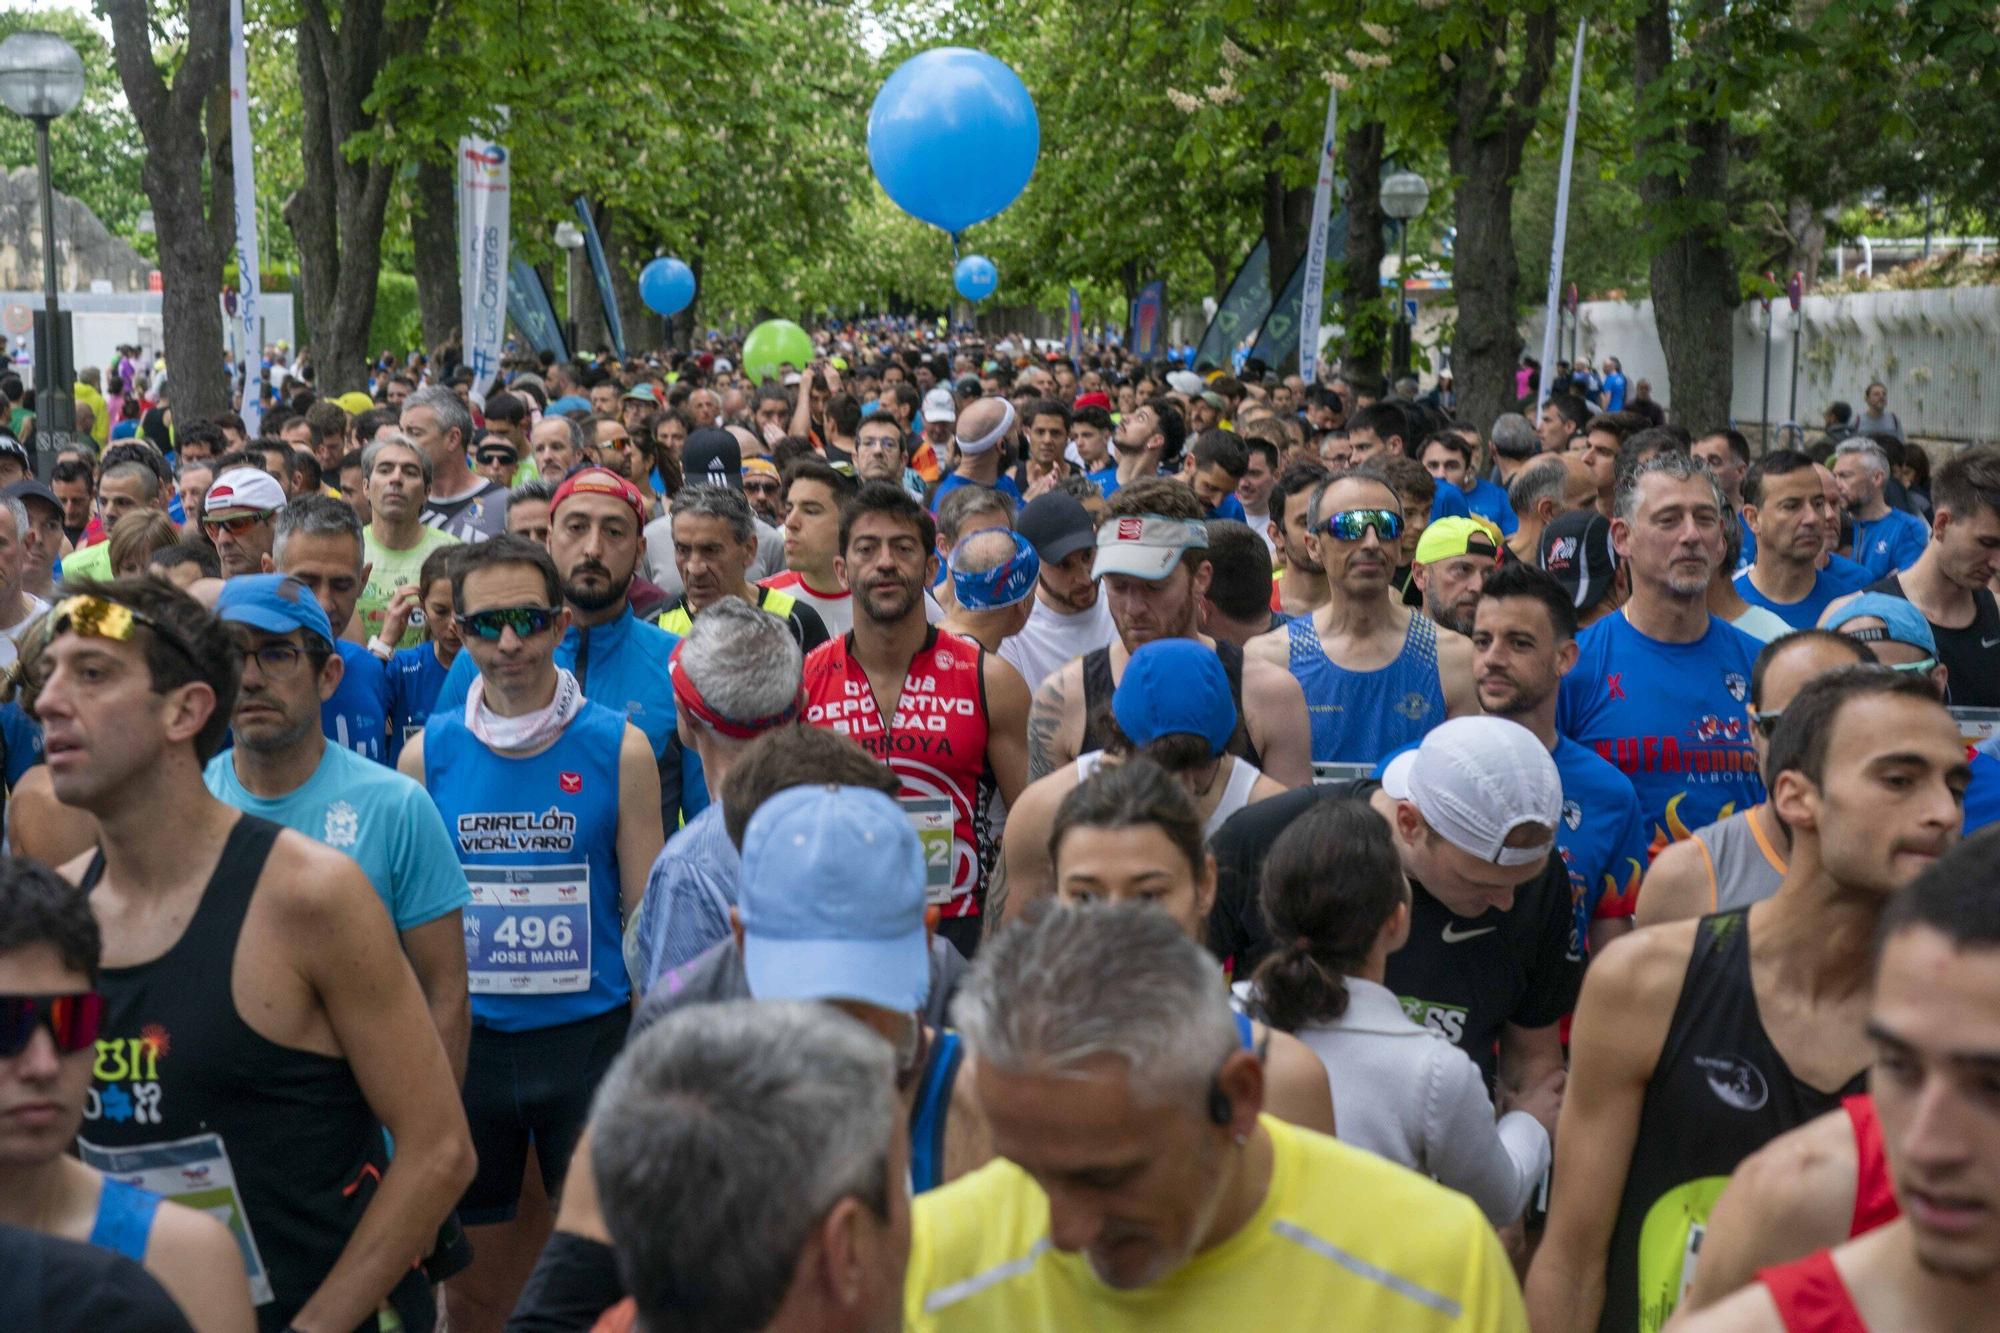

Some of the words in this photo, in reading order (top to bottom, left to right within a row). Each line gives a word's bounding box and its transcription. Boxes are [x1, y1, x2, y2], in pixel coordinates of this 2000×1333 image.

[807, 693, 974, 722] DEPORTIVO
[493, 914, 573, 949] 496
[488, 950, 527, 964] JOSE
[531, 948, 579, 963] MARIA
